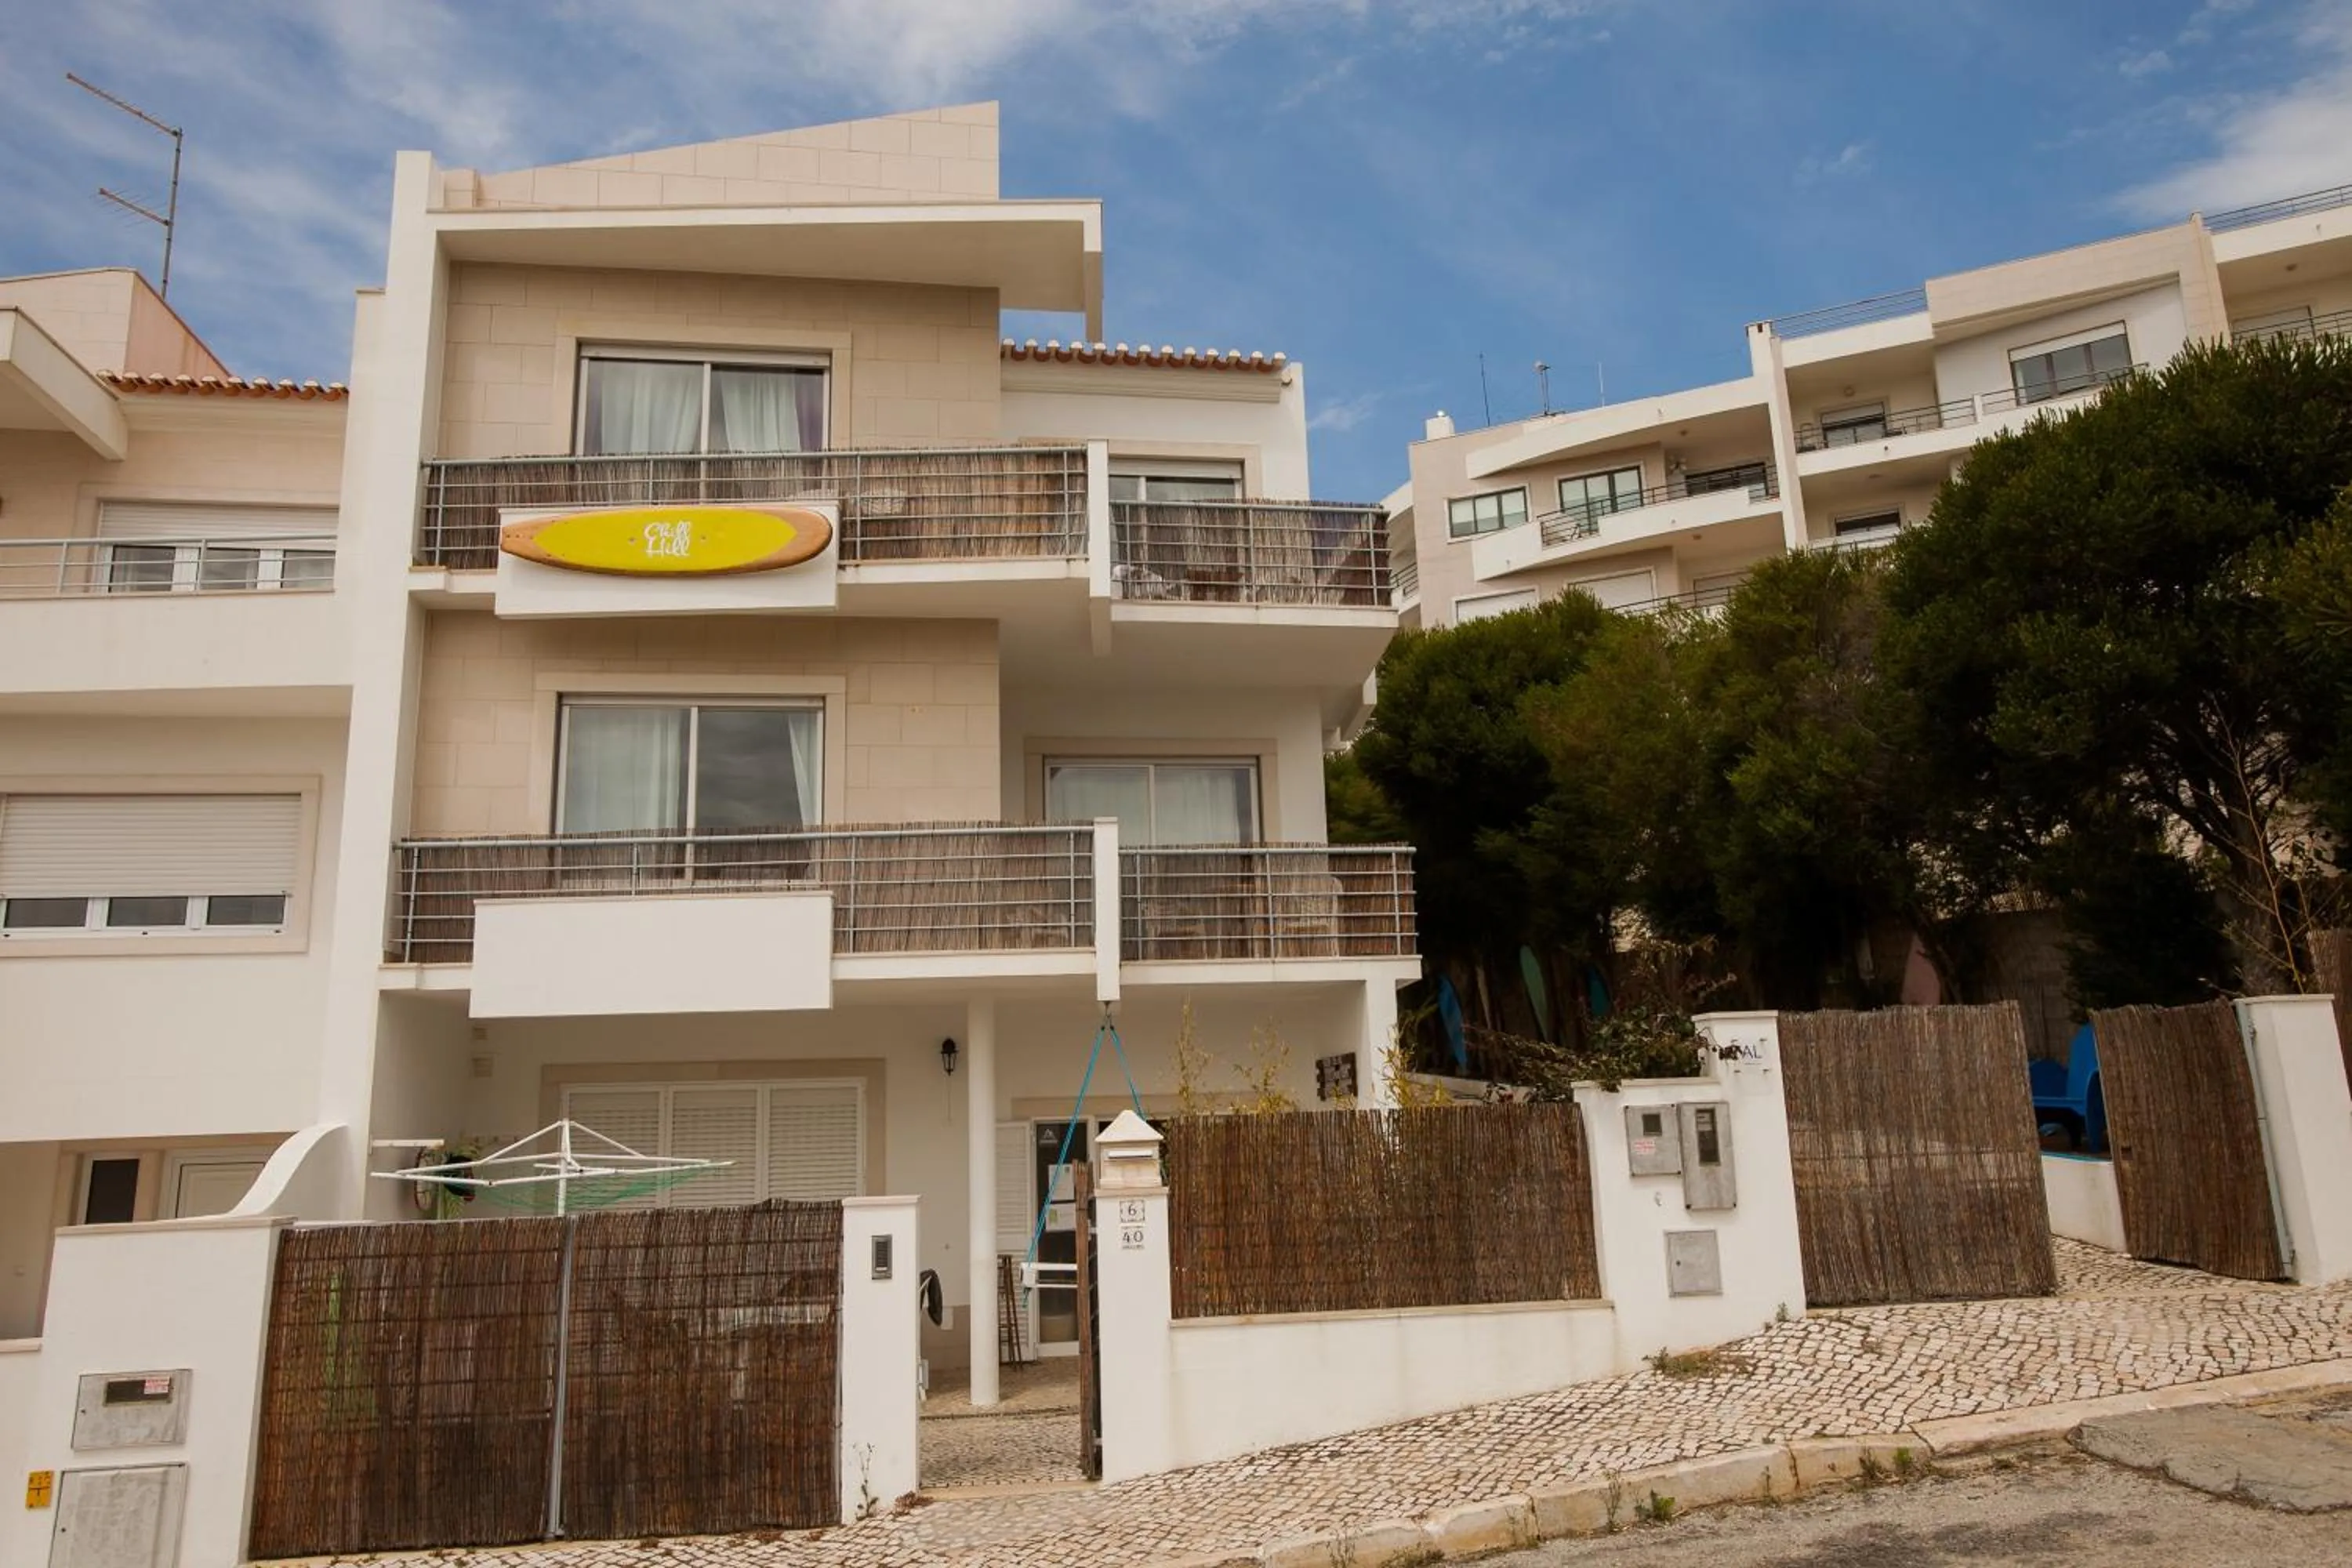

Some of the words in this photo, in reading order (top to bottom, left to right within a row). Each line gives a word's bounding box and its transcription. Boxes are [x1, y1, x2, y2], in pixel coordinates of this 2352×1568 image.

[645, 537, 691, 558] Hill
[1128, 1203, 1137, 1216] 6
[1123, 1231, 1144, 1243] 40
